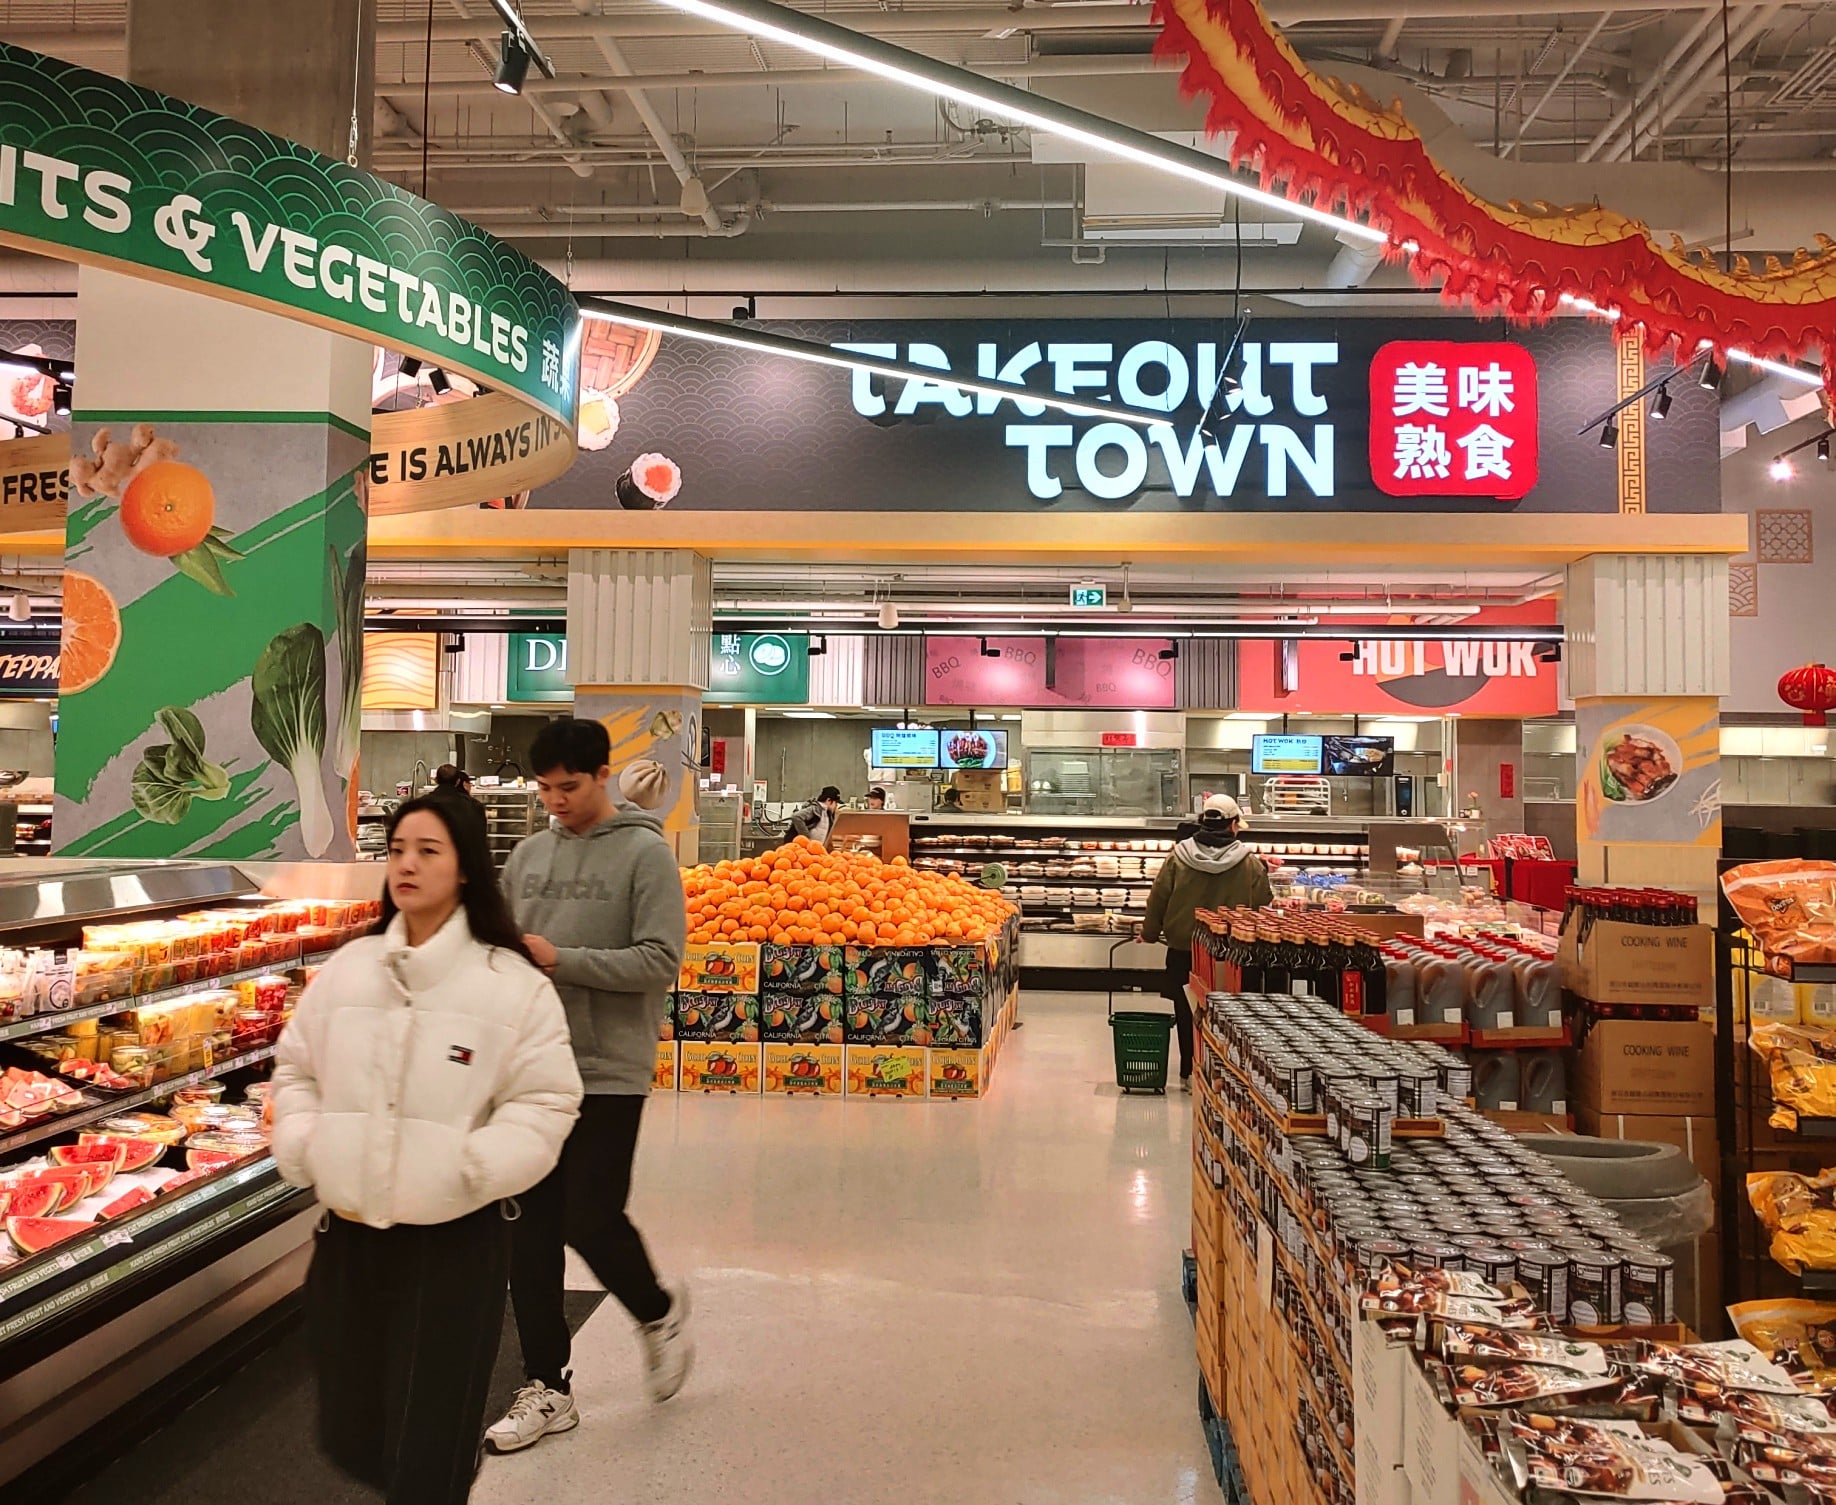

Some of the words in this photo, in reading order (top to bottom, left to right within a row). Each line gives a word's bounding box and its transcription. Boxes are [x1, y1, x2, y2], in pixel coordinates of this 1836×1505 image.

[154, 194, 216, 273] &
[231, 211, 528, 373] VEGETABLES
[831, 340, 1339, 417] TAKEOUT
[1392, 361, 1516, 417] 美味
[401, 447, 427, 481] IS
[435, 421, 531, 477] ALWAYS
[535, 415, 550, 451] IN
[1005, 421, 1335, 500] TOWN
[1393, 423, 1515, 481] 熟食
[932, 656, 960, 679] BBQ
[1005, 646, 1037, 666] BBQ
[1132, 648, 1172, 680] BBQ
[1442, 641, 1537, 677] WOK
[1621, 936, 1660, 948] COOKING
[1666, 936, 1688, 948] WINE
[763, 981, 802, 990] CALIFORNIA
[678, 1030, 717, 1039] CALIFORNIA
[763, 1031, 802, 1039] CALIFORNIA
[847, 1033, 887, 1042] CALIFORNIA
[1623, 1044, 1662, 1056] COOKING
[1667, 1045, 1689, 1057] WINE
[26, 1305, 44, 1321] FRUIT
[43, 1300, 57, 1313] AND
[55, 1282, 89, 1306] VEGETABLES
